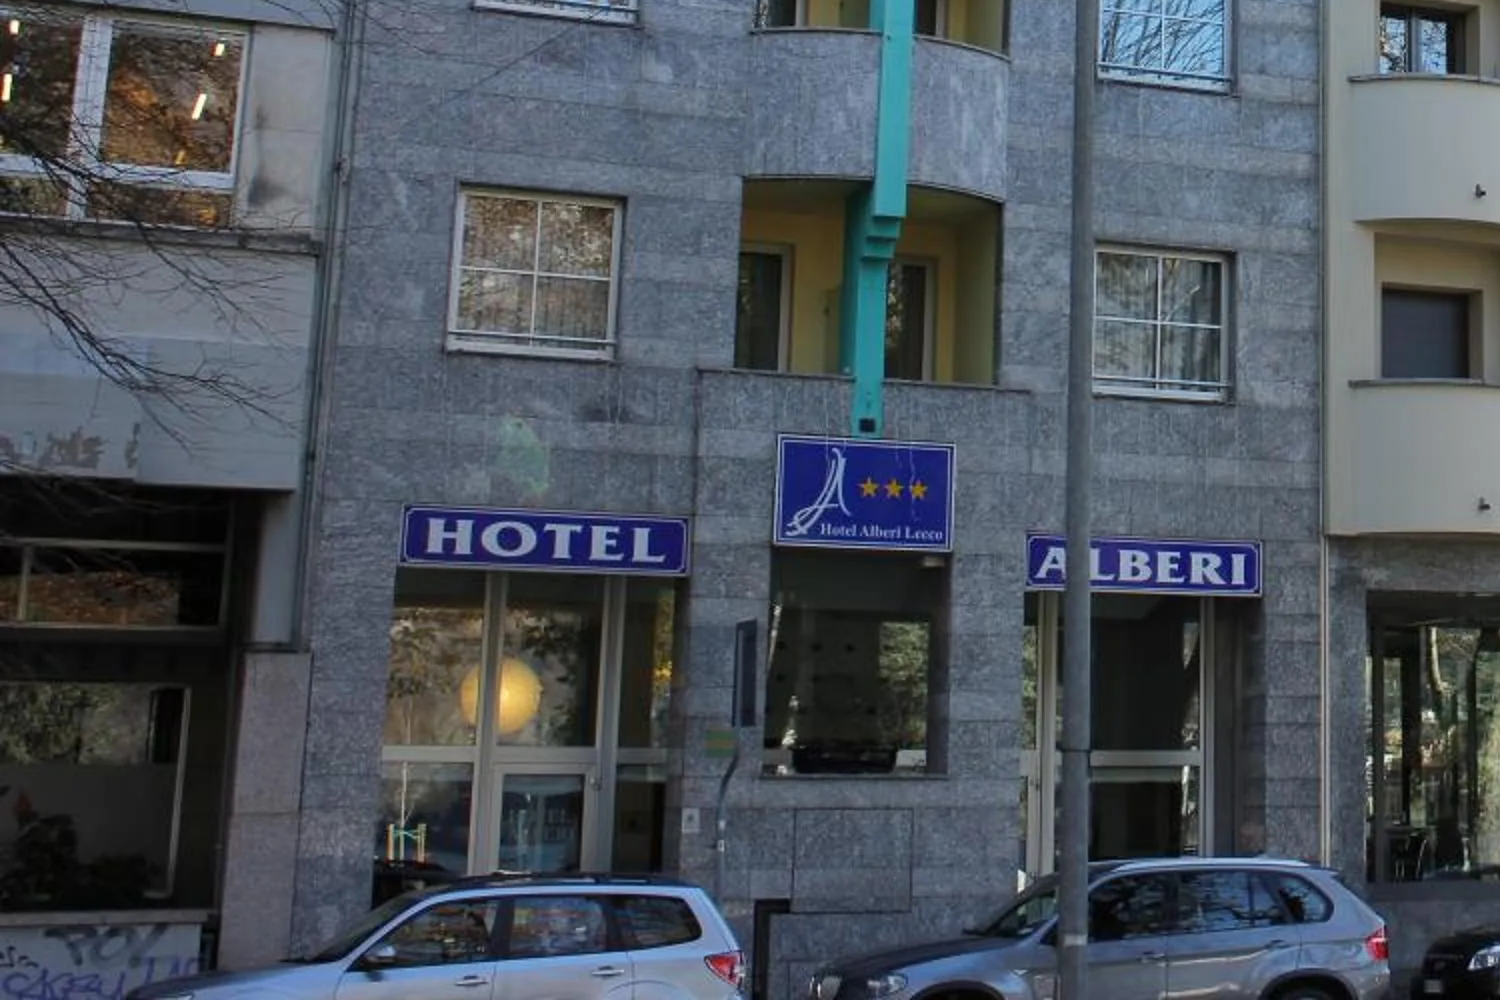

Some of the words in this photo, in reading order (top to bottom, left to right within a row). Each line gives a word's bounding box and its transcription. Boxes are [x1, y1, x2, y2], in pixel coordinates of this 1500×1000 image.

[425, 517, 667, 564] HOTEL
[820, 522, 857, 537] Hotel
[859, 524, 901, 540] Alberi
[905, 526, 943, 541] Lecco
[1034, 546, 1246, 585] ALBERI
